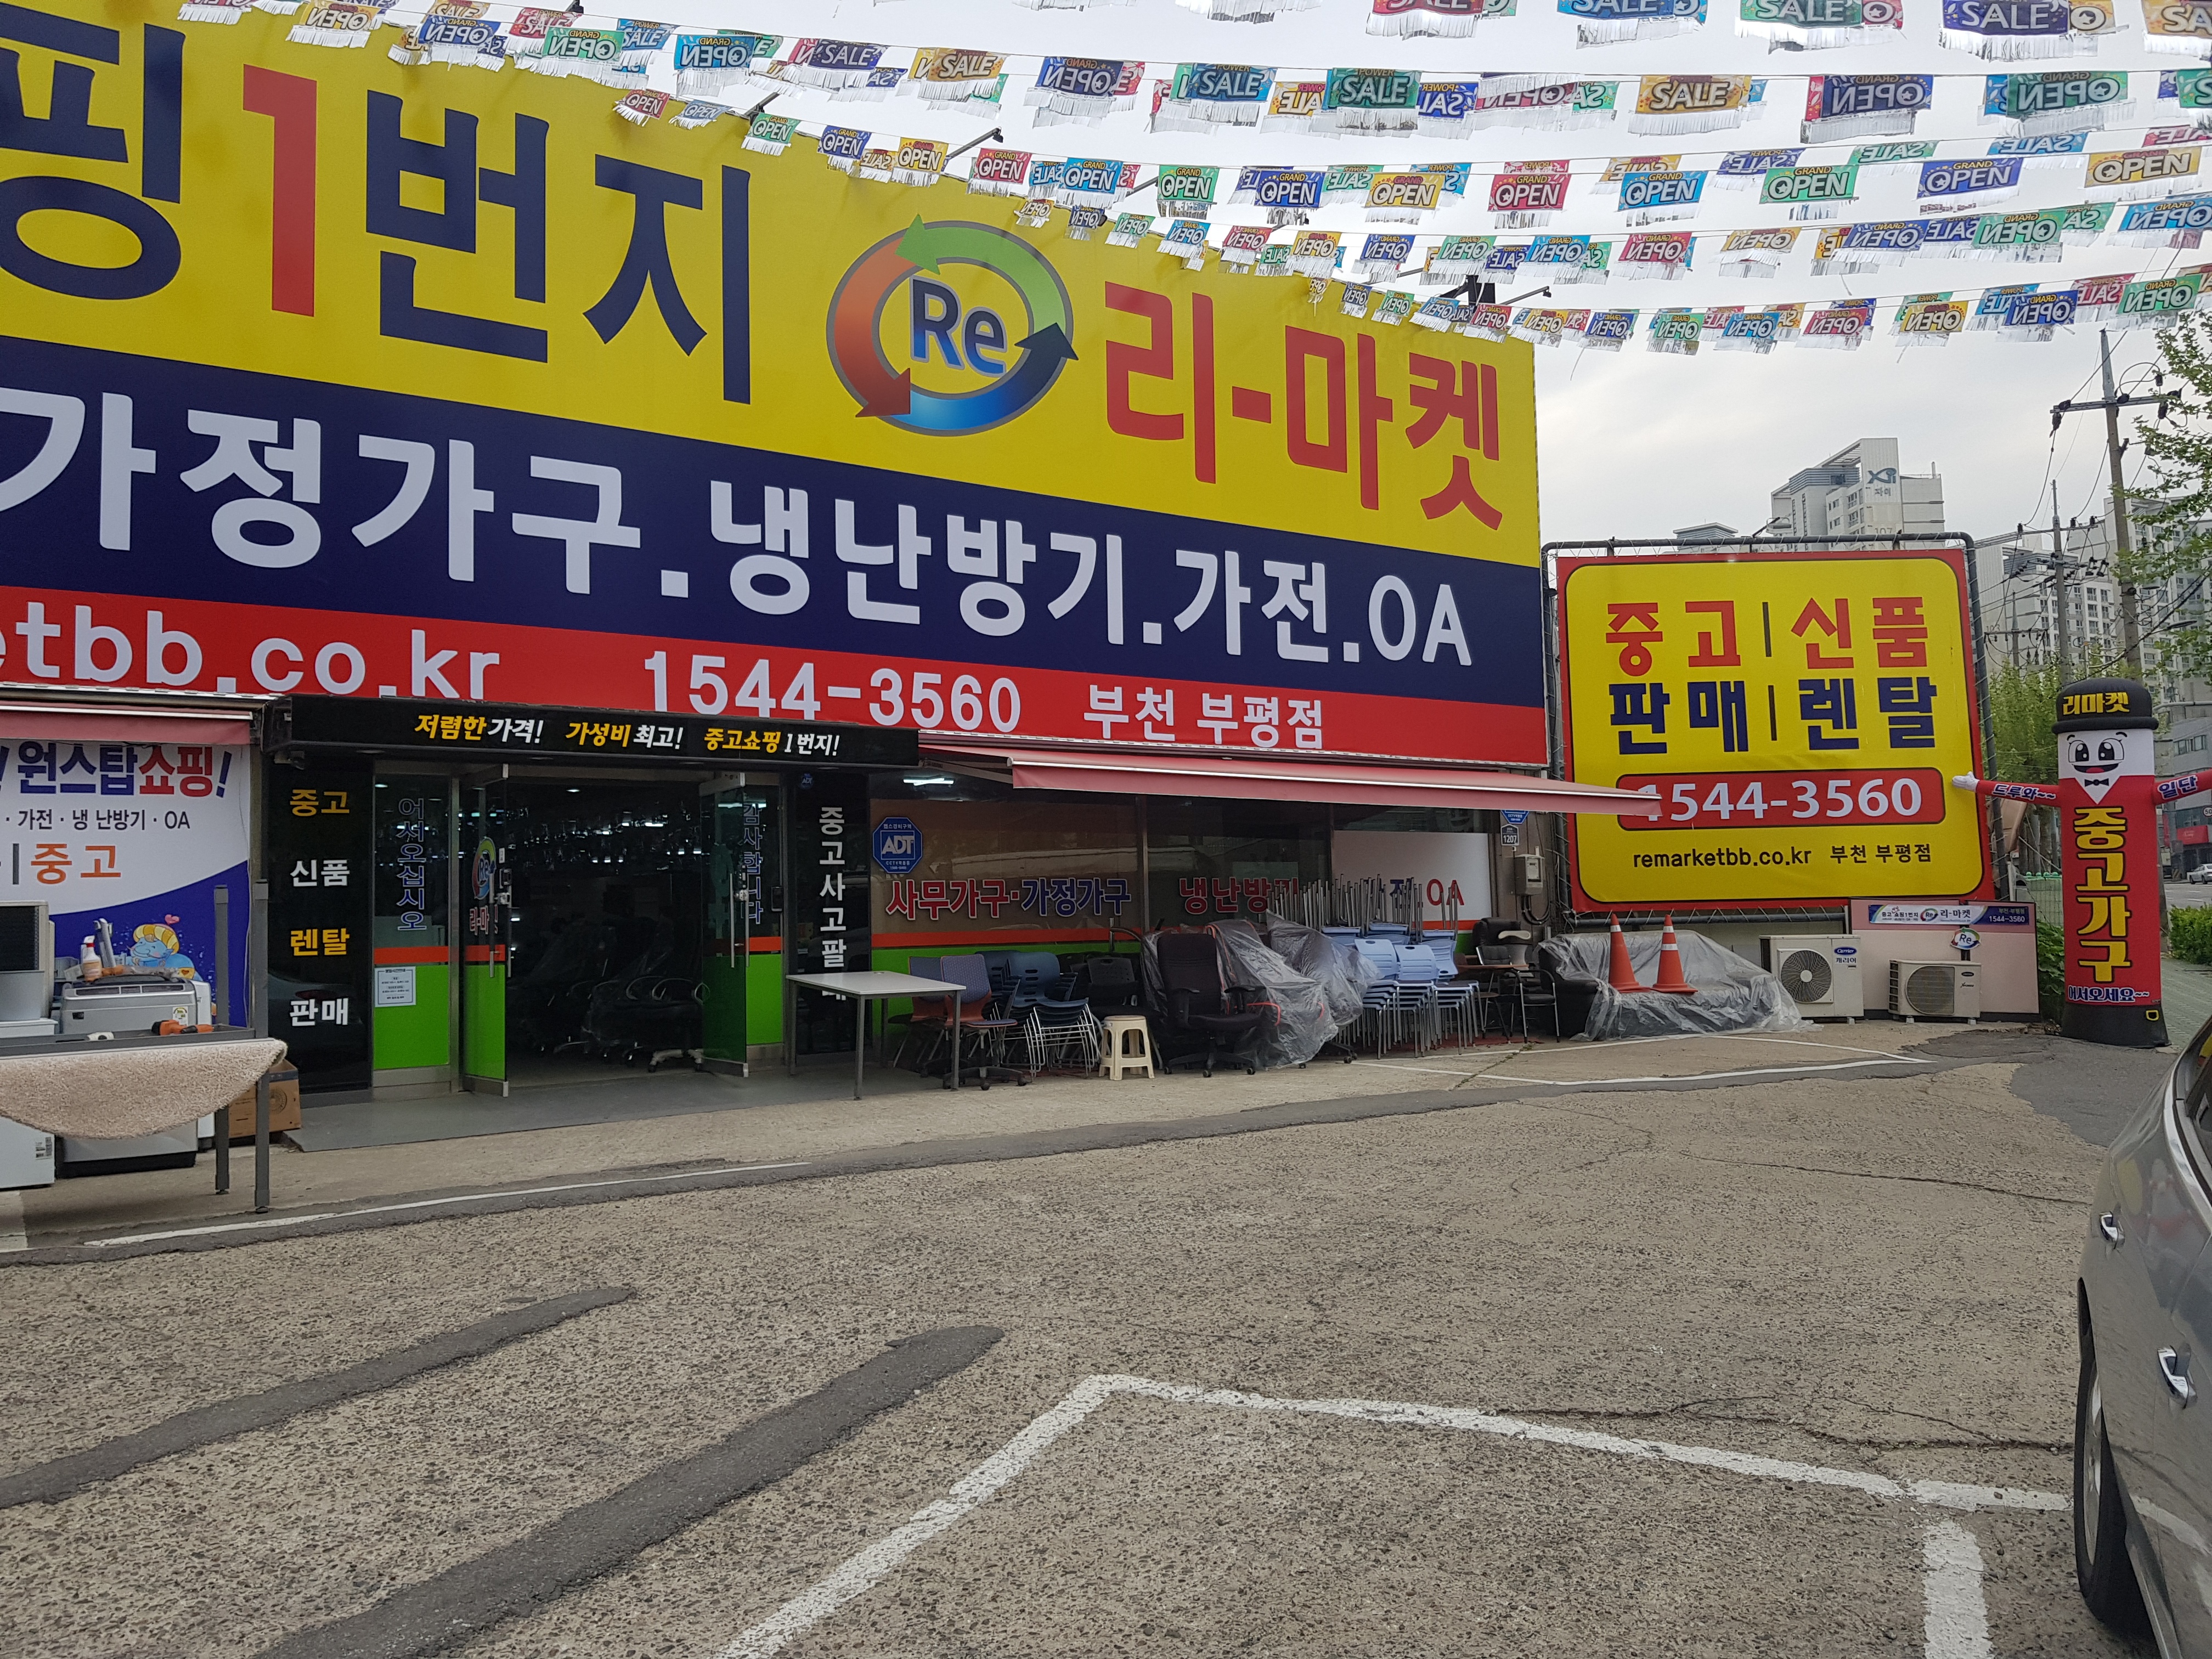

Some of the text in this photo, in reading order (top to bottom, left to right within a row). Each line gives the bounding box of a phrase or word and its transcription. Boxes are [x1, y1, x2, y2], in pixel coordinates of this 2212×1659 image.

[1756, 0, 1844, 21] SALE
[1961, 2, 2050, 29] SALE
[822, 44, 874, 66] SALE
[939, 54, 996, 78] SALE
[1199, 71, 1264, 98] SALE
[1340, 75, 1410, 106] SALE
[1650, 81, 1730, 110] SALE
[627, 94, 663, 114] OPEN
[753, 120, 791, 141] OPEN
[823, 134, 863, 156] OPEN
[995, 151, 1016, 160] GRAND
[898, 148, 941, 171] OPEN
[978, 157, 1023, 181] OPEN
[1083, 161, 1106, 170] GRAND
[1795, 166, 1832, 175] GRAND
[1953, 160, 1993, 170] GRAND
[2093, 154, 2192, 183] OPEN
[1063, 167, 1115, 191] OPEN
[1177, 168, 1201, 177] GRAND
[1279, 173, 1306, 182] GRAND
[1394, 176, 1424, 184] GRAND
[1516, 175, 1548, 183] GRAND
[1649, 172, 1682, 180] GRAND
[1926, 166, 2012, 193] OPEN
[1161, 174, 1212, 200] OPEN
[1261, 181, 1316, 205] OPEN
[1372, 183, 1436, 207] OPEN
[1495, 183, 1562, 207] OPEN
[1626, 179, 1699, 205] OPEN
[1768, 172, 1849, 199] OPEN
[910, 276, 1008, 379] Re
[1104, 281, 1504, 531] 리-마켓
[1874, 487, 1891, 496] 자이
[1605, 596, 1929, 677] 중고 신품
[644, 651, 1022, 733] 1544-3560
[2062, 692, 2130, 715] 리마켓
[1084, 684, 1323, 750] 부천 부평점
[1609, 676, 1938, 755] 판매 렌탈
[2157, 775, 2198, 800] 일단
[289, 789, 351, 817] 중고
[164, 810, 190, 830] OA
[882, 835, 915, 854] ADT
[1503, 835, 1517, 843] 1207
[30, 843, 121, 885] 중고
[396, 797, 428, 932] 어서오십시오
[1633, 847, 1812, 868] remarketbb.co.kr
[1830, 843, 1932, 864] 부천 부평점
[290, 859, 351, 887] 신품
[2074, 805, 2132, 983] 중고가구
[1940, 909, 1971, 918] 리-마켓
[290, 927, 351, 956] 렌탈
[1959, 933, 1972, 945] Re
[289, 997, 349, 1026] 판매
